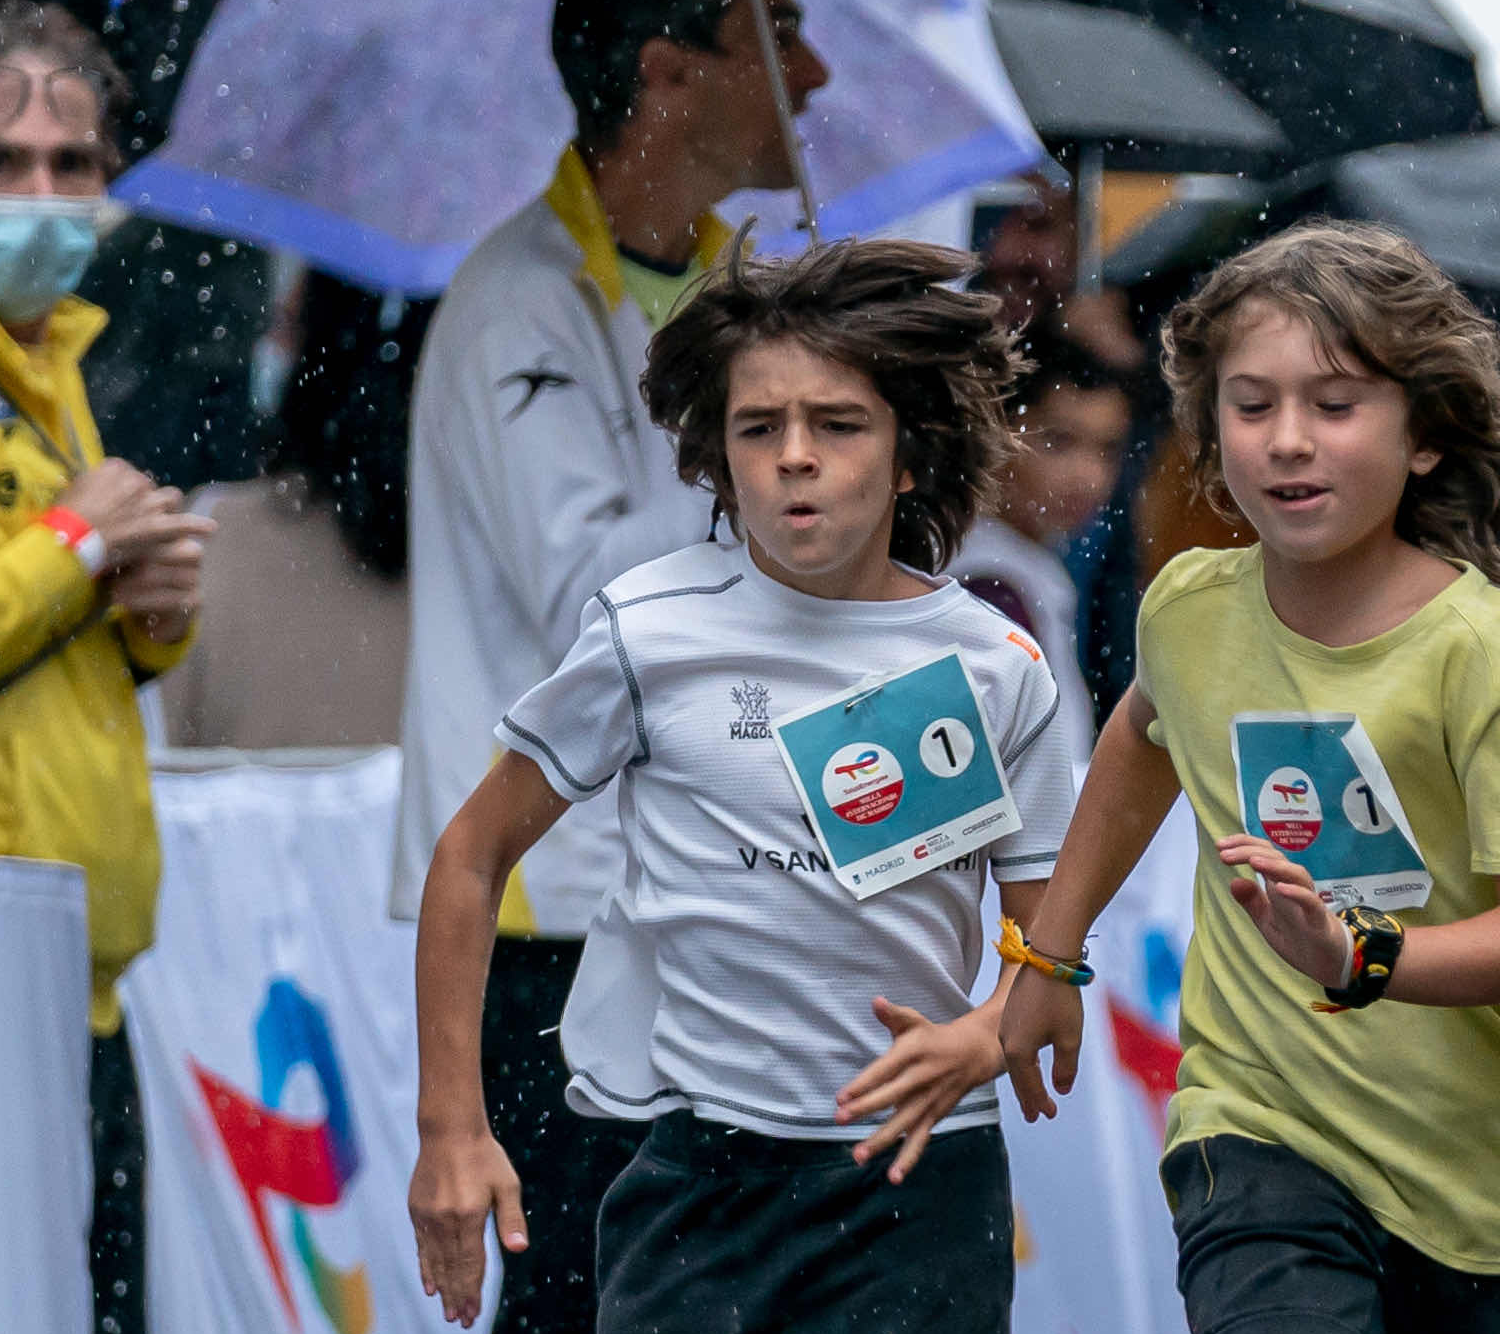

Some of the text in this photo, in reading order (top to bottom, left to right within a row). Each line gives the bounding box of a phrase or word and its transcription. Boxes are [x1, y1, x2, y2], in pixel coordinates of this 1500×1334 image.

[931, 726, 957, 768] 1
[1356, 784, 1380, 827] 1
[738, 847, 759, 870] V
[864, 856, 906, 879] MADRID
